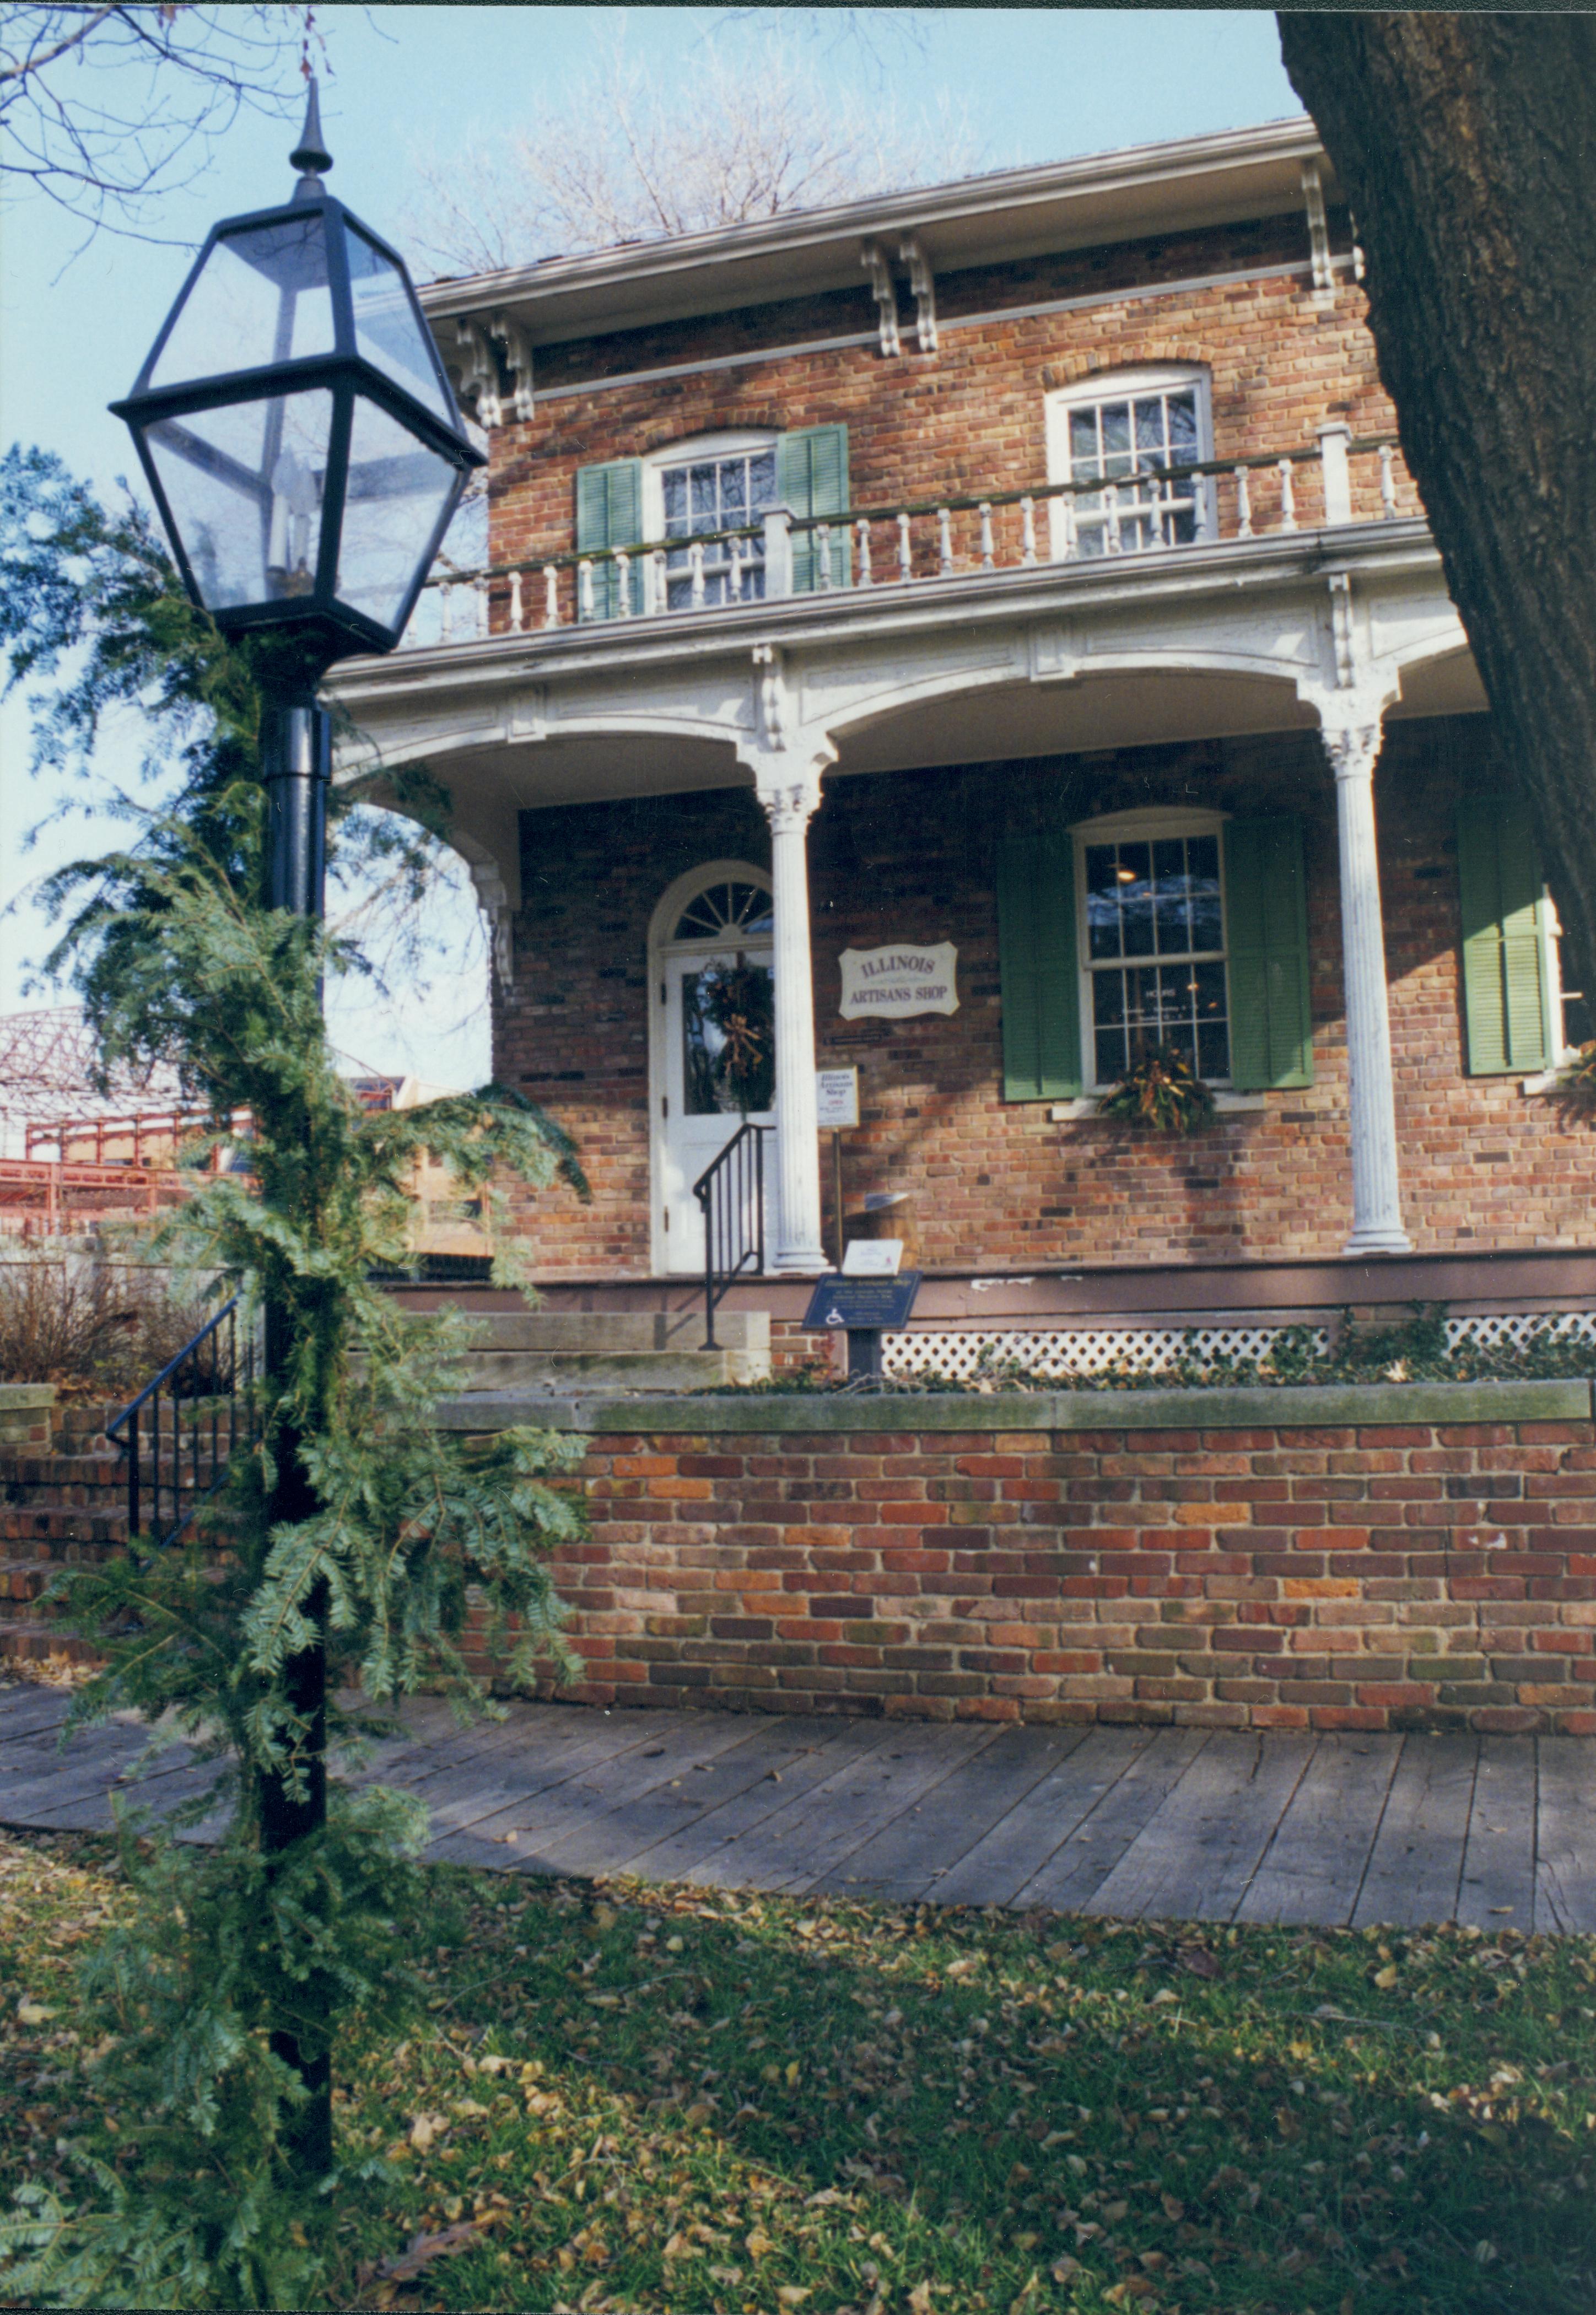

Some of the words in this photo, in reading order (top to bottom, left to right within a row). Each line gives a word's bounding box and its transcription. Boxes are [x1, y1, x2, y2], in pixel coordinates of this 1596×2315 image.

[861, 956, 935, 978] ILLINOIS
[850, 987, 911, 1005] ARTISANS
[915, 985, 948, 1000] SHOP
